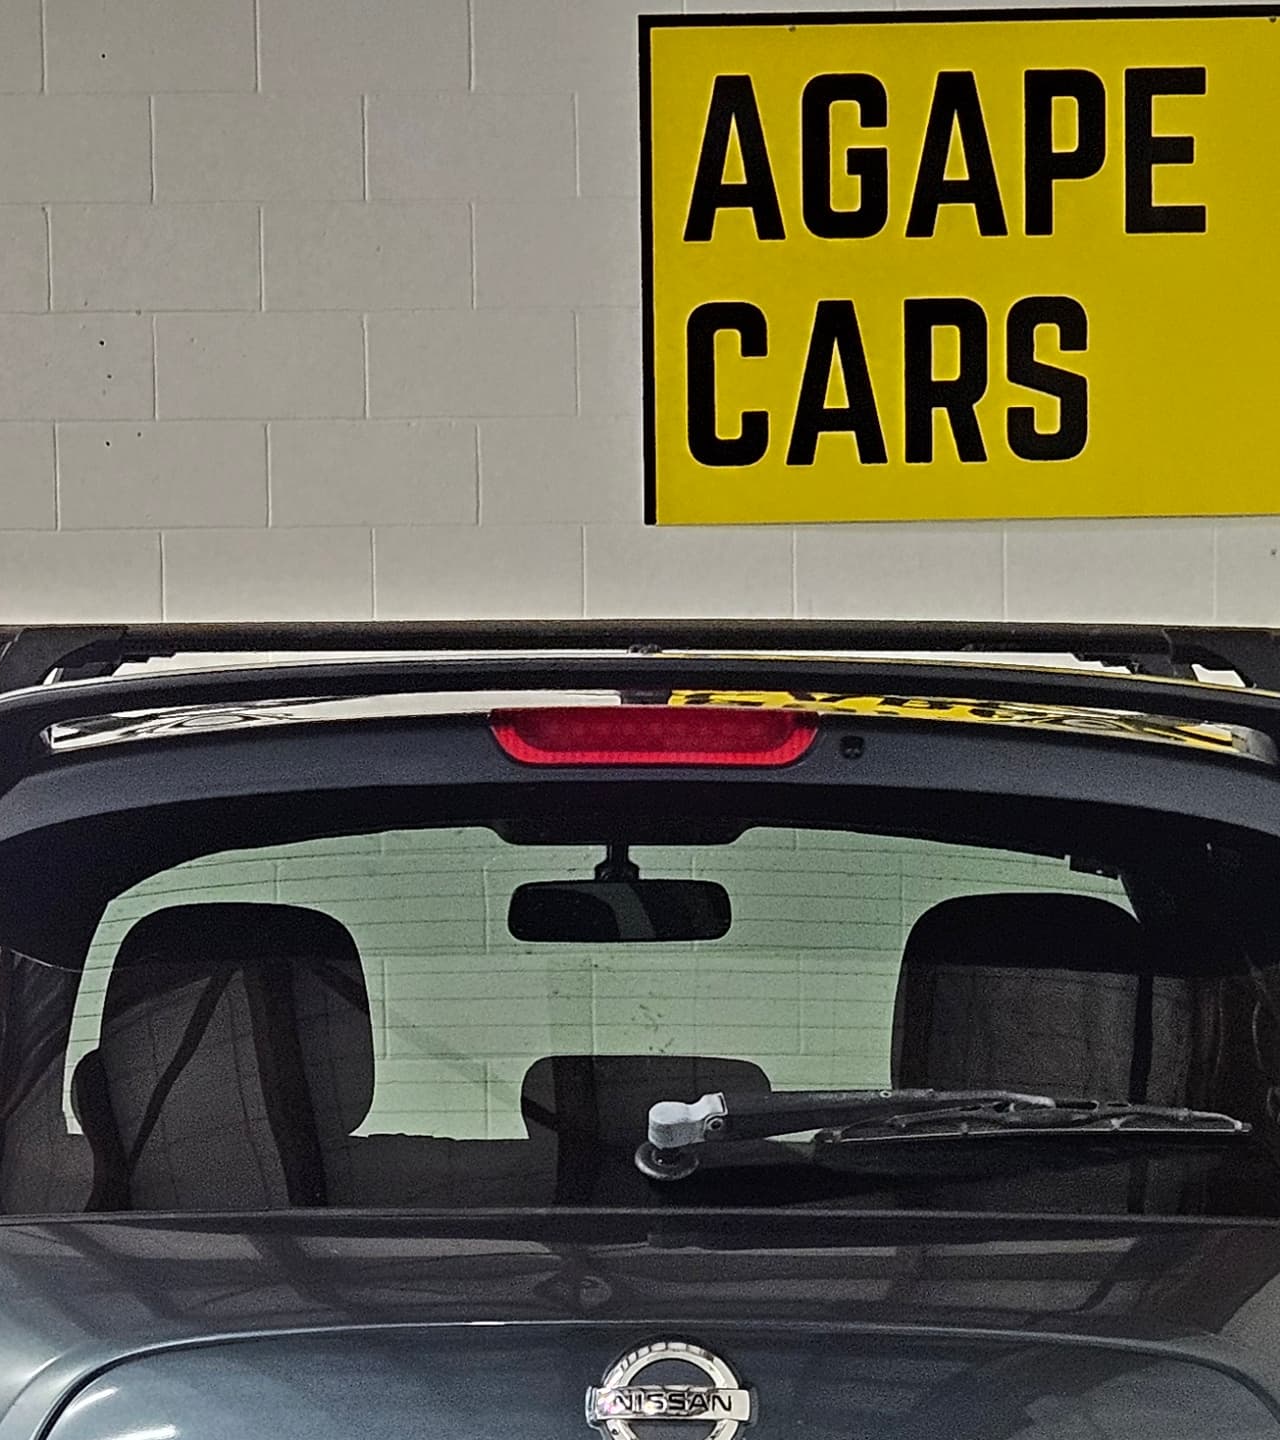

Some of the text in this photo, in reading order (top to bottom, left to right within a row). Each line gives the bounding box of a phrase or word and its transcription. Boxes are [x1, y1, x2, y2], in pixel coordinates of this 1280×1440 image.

[682, 66, 1207, 242] AGAPE
[686, 295, 1089, 467] CARS
[614, 1392, 732, 1413] NISSAN
